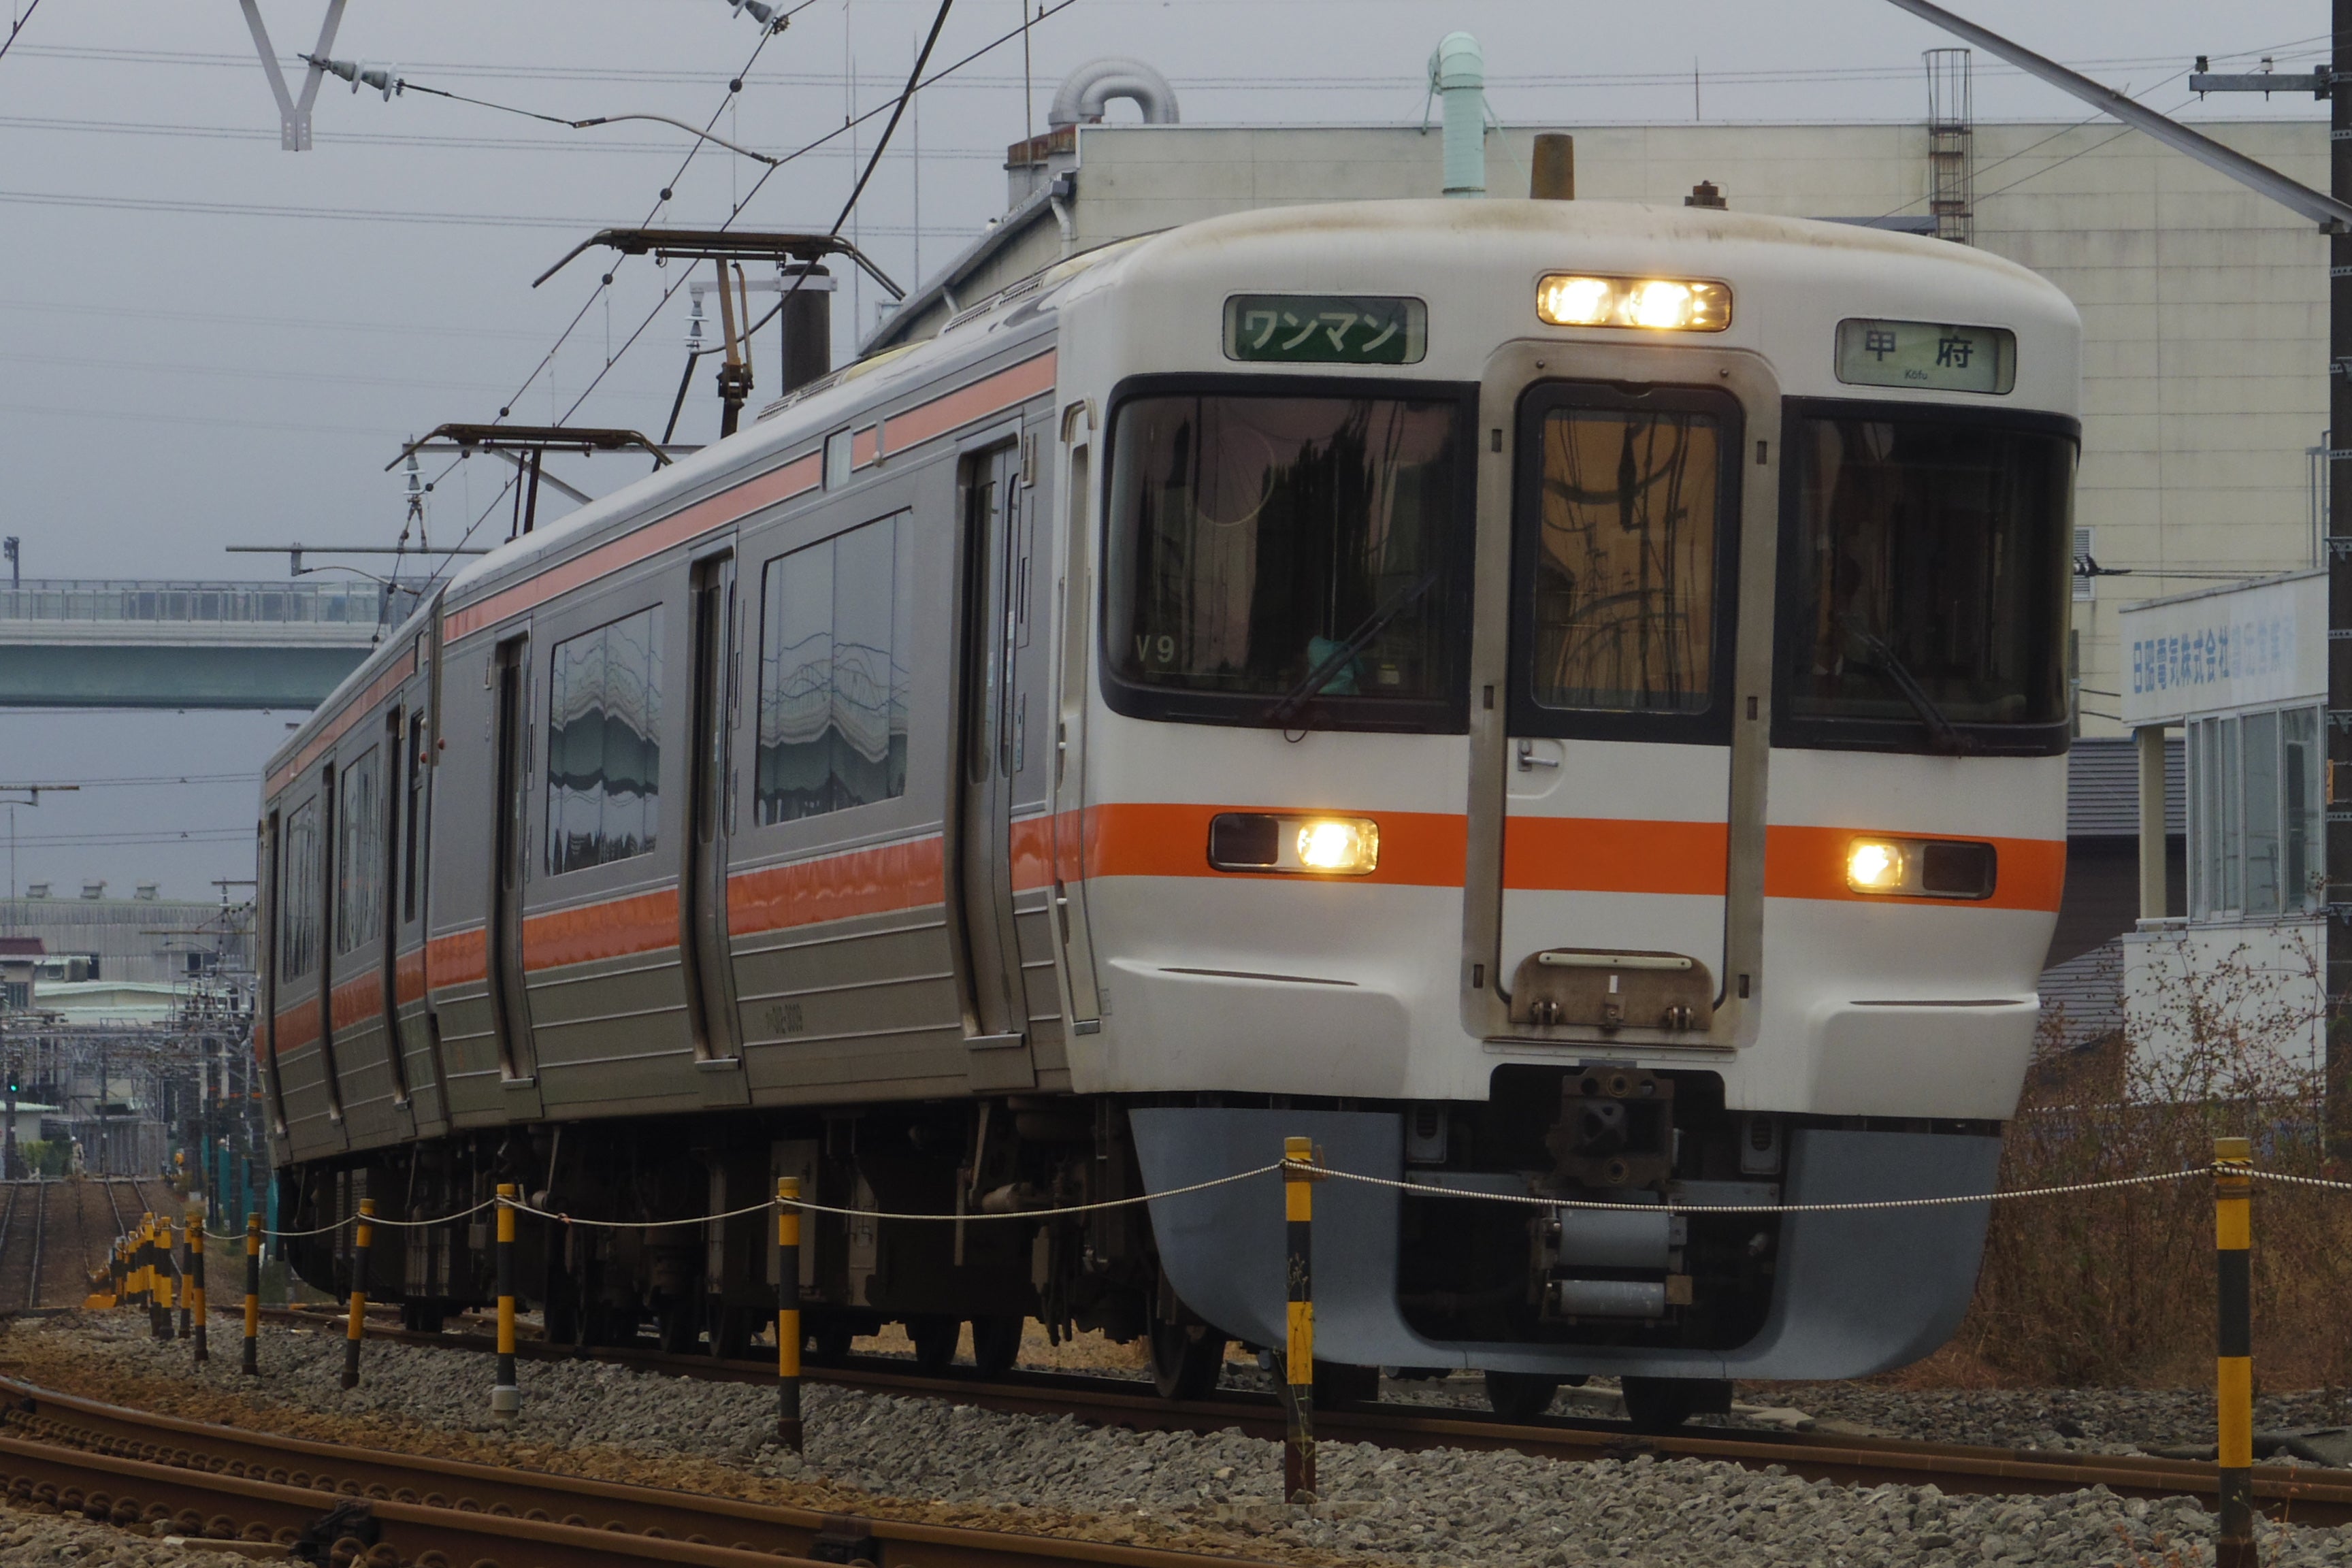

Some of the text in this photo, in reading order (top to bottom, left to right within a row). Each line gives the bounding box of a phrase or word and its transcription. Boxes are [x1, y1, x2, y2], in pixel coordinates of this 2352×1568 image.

[1245, 310, 1399, 353] ワンマン
[1865, 329, 1974, 368] 甲府
